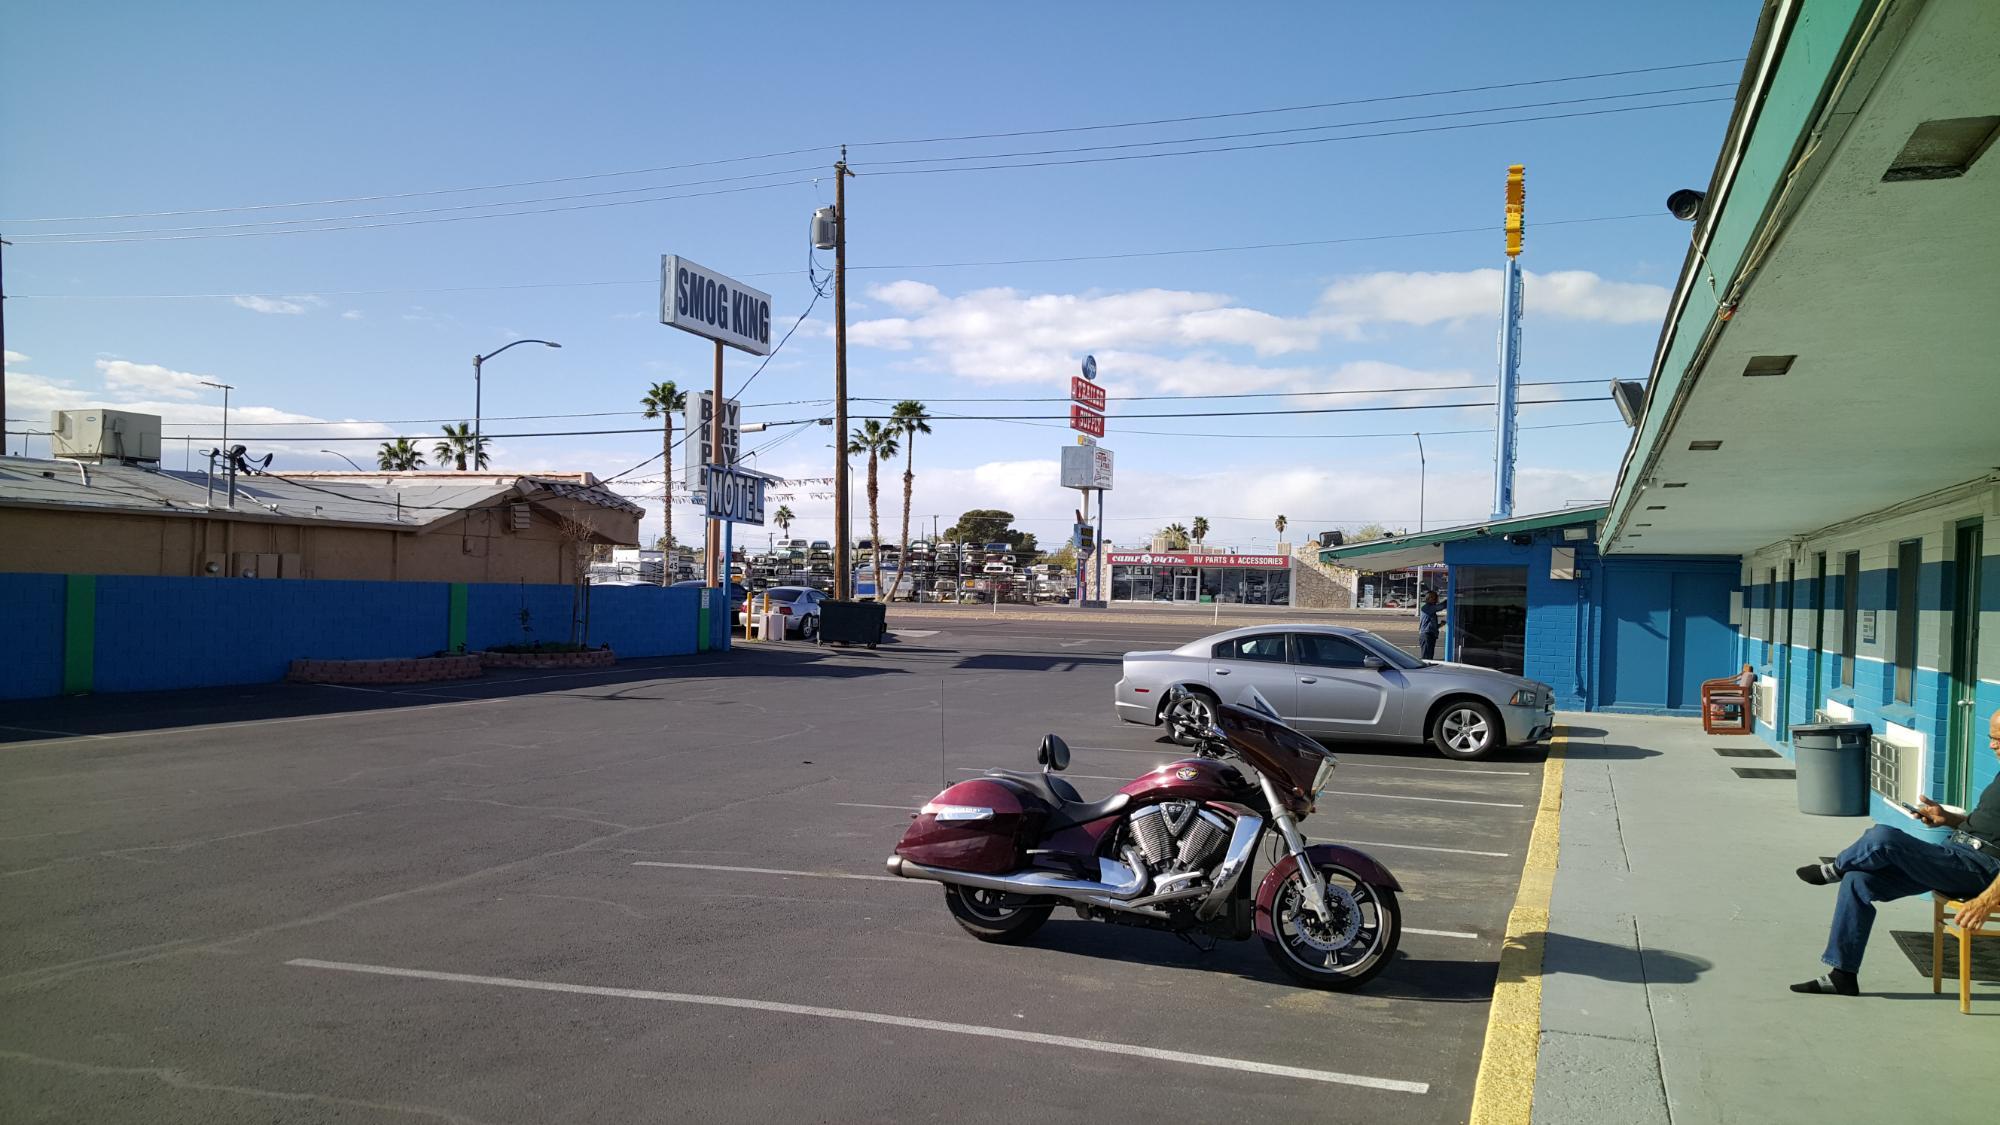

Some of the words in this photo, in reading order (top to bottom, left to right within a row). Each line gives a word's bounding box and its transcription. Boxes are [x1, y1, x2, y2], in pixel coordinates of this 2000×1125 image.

[678, 267, 728, 330] SMOG
[732, 289, 769, 344] KING
[1077, 380, 1104, 408] TRAILER
[1080, 409, 1102, 433] SUPPLY
[701, 422, 738, 446] HRE
[710, 468, 764, 524] MOTEL
[670, 562, 678, 570] 45
[1126, 565, 1153, 575] YETI
[1205, 556, 1227, 564] PARTS
[1238, 557, 1283, 565] ACCESSORIES
